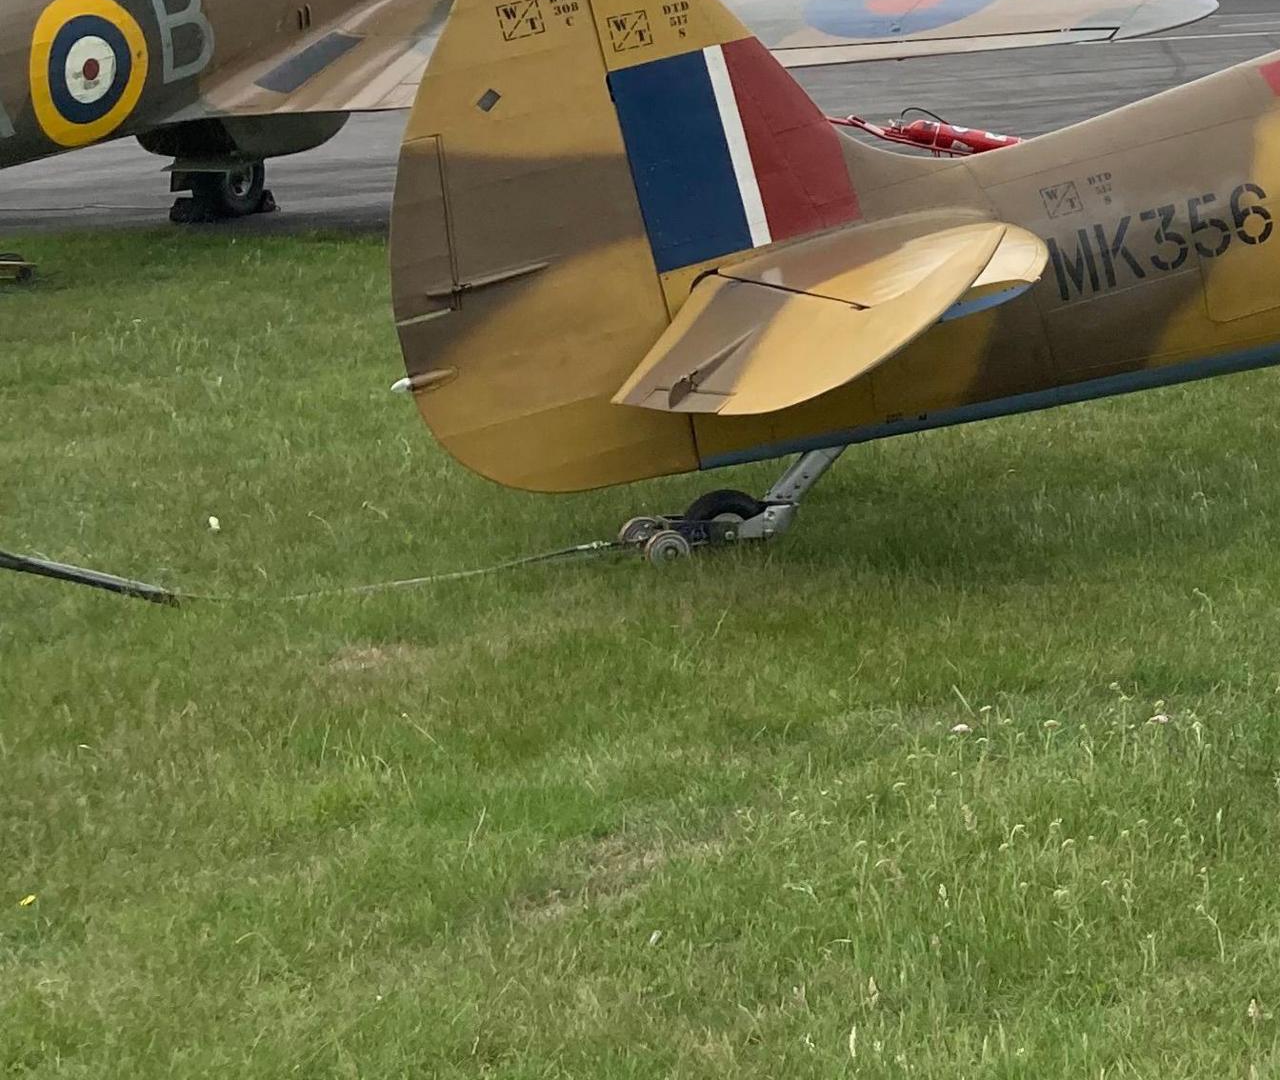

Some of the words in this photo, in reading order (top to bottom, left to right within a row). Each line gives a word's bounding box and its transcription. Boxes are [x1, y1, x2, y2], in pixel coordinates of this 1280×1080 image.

[502, 5, 519, 21] W
[553, 2, 579, 17] 308
[662, 1, 690, 16] DTD
[525, 17, 538, 31] T
[611, 18, 628, 33] W
[634, 28, 647, 42] T
[1046, 183, 1273, 301] MK356
